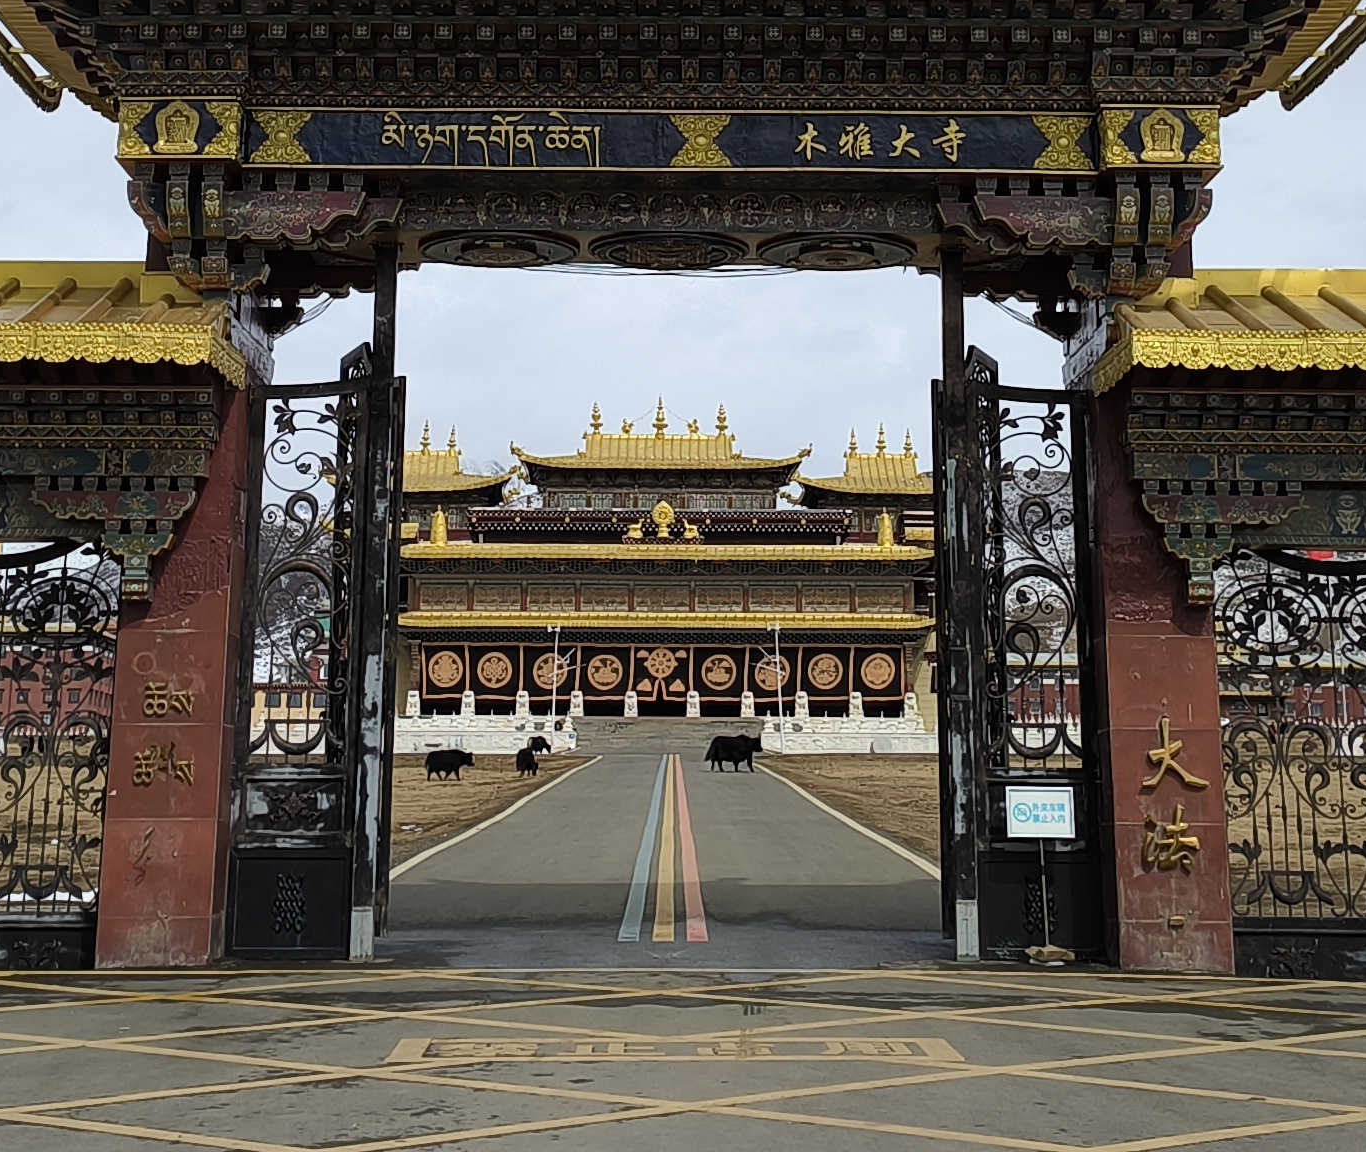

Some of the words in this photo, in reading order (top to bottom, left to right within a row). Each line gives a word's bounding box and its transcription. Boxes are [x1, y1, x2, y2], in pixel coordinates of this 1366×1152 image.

[794, 118, 967, 164] 木雅大寺
[1032, 813, 1066, 824] 禁止入内
